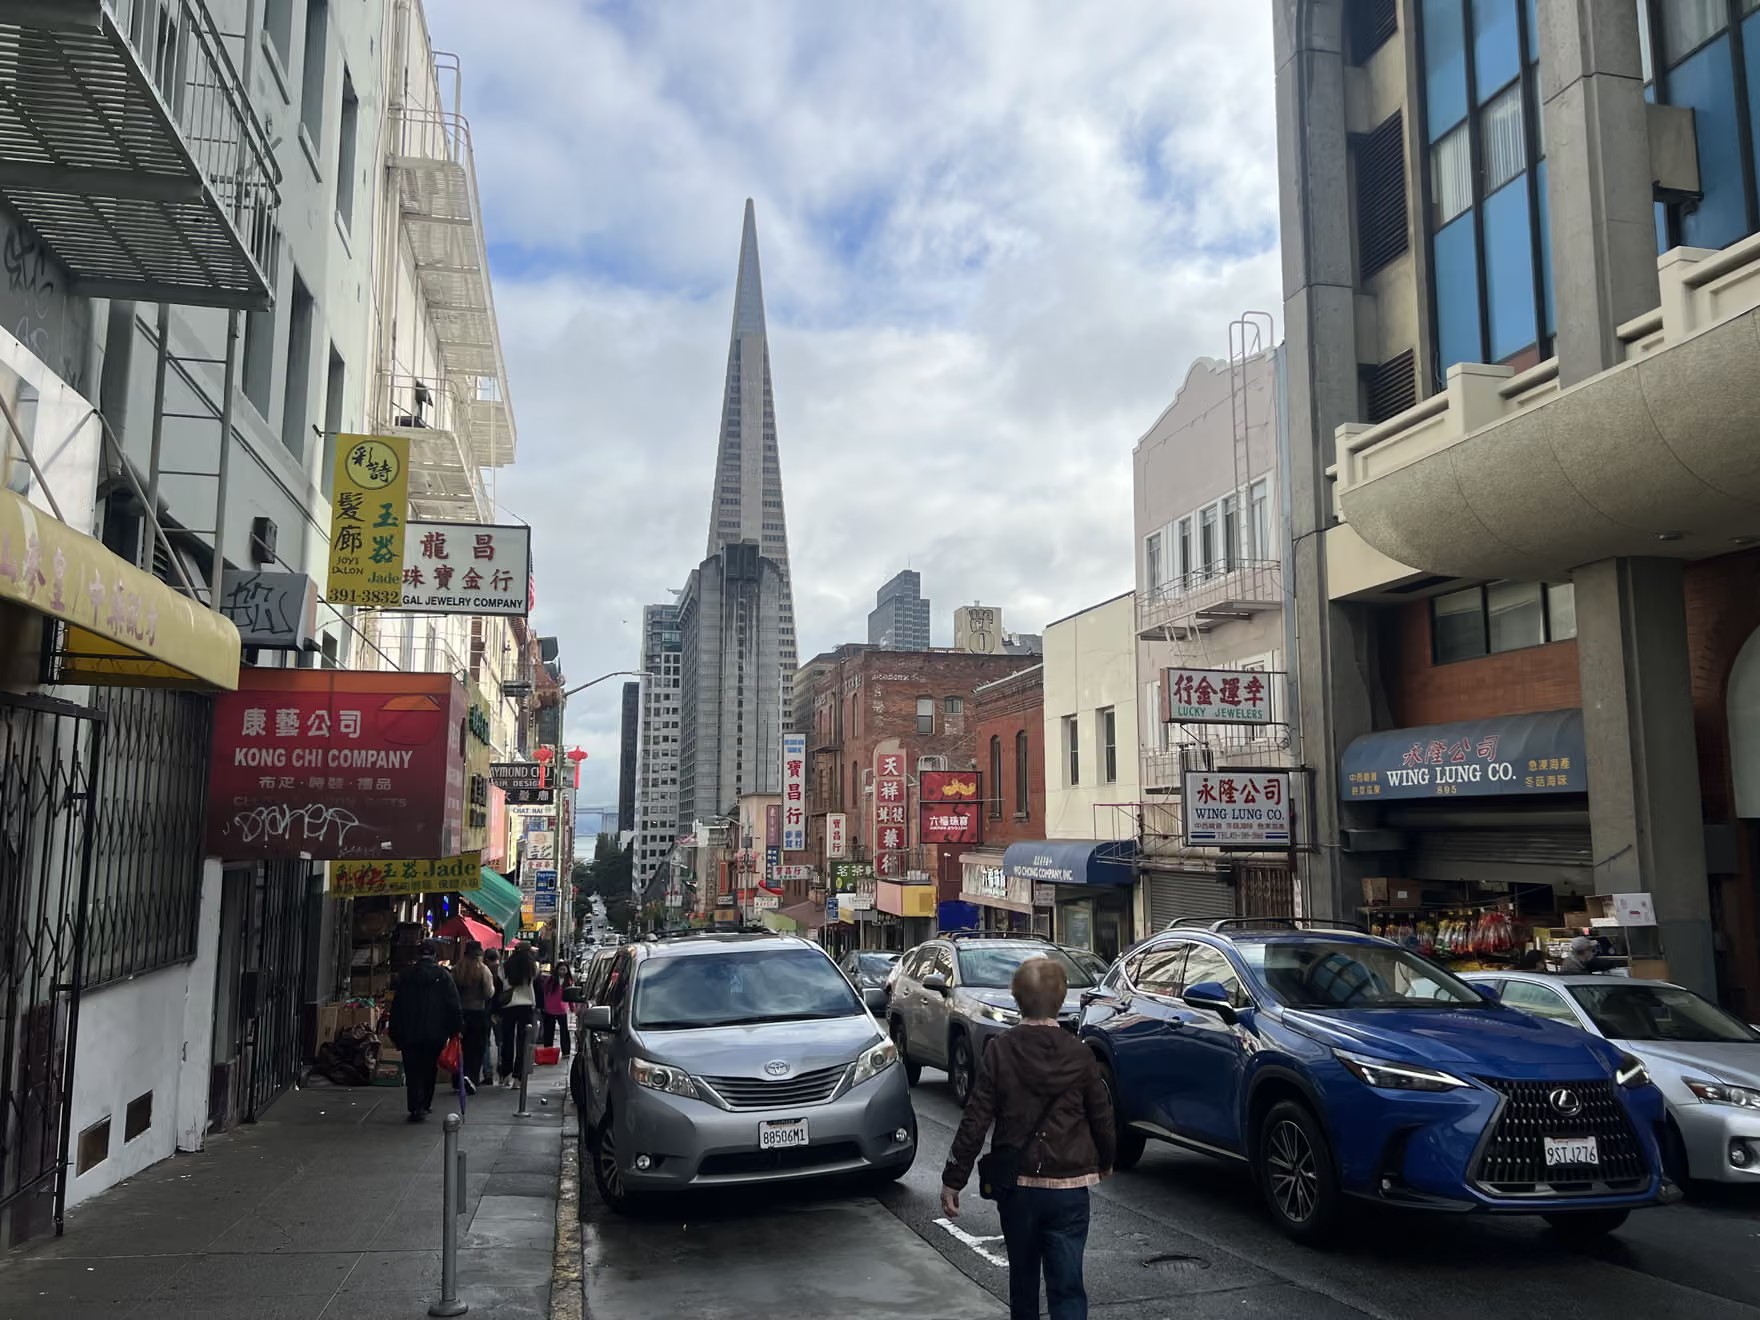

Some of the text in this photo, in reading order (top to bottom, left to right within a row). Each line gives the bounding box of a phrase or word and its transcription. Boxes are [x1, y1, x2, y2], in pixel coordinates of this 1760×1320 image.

[368, 502, 400, 564] 玉器
[420, 531, 496, 560] 龍昌
[368, 571, 400, 584] Jade
[402, 564, 514, 592] 珠寶金行
[329, 588, 400, 604] 391-3832
[425, 596, 471, 607] JEWELRY
[473, 598, 523, 608] COMPANY
[241, 708, 362, 738] 康藝公司
[1177, 707, 1263, 720] LUCKY JEWELERS
[234, 748, 413, 769] KONG CHI COMPANY
[1386, 762, 1517, 787] WING LUNG CO.
[787, 760, 803, 825] 寶昌行
[1197, 778, 1282, 805] 永隆公司
[1436, 786, 1457, 794] 895
[1195, 808, 1285, 820] WING LUNG CO.
[423, 859, 476, 878] Jade
[763, 1128, 805, 1144] 88506M1
[1547, 1146, 1597, 1164] 9STJ276
